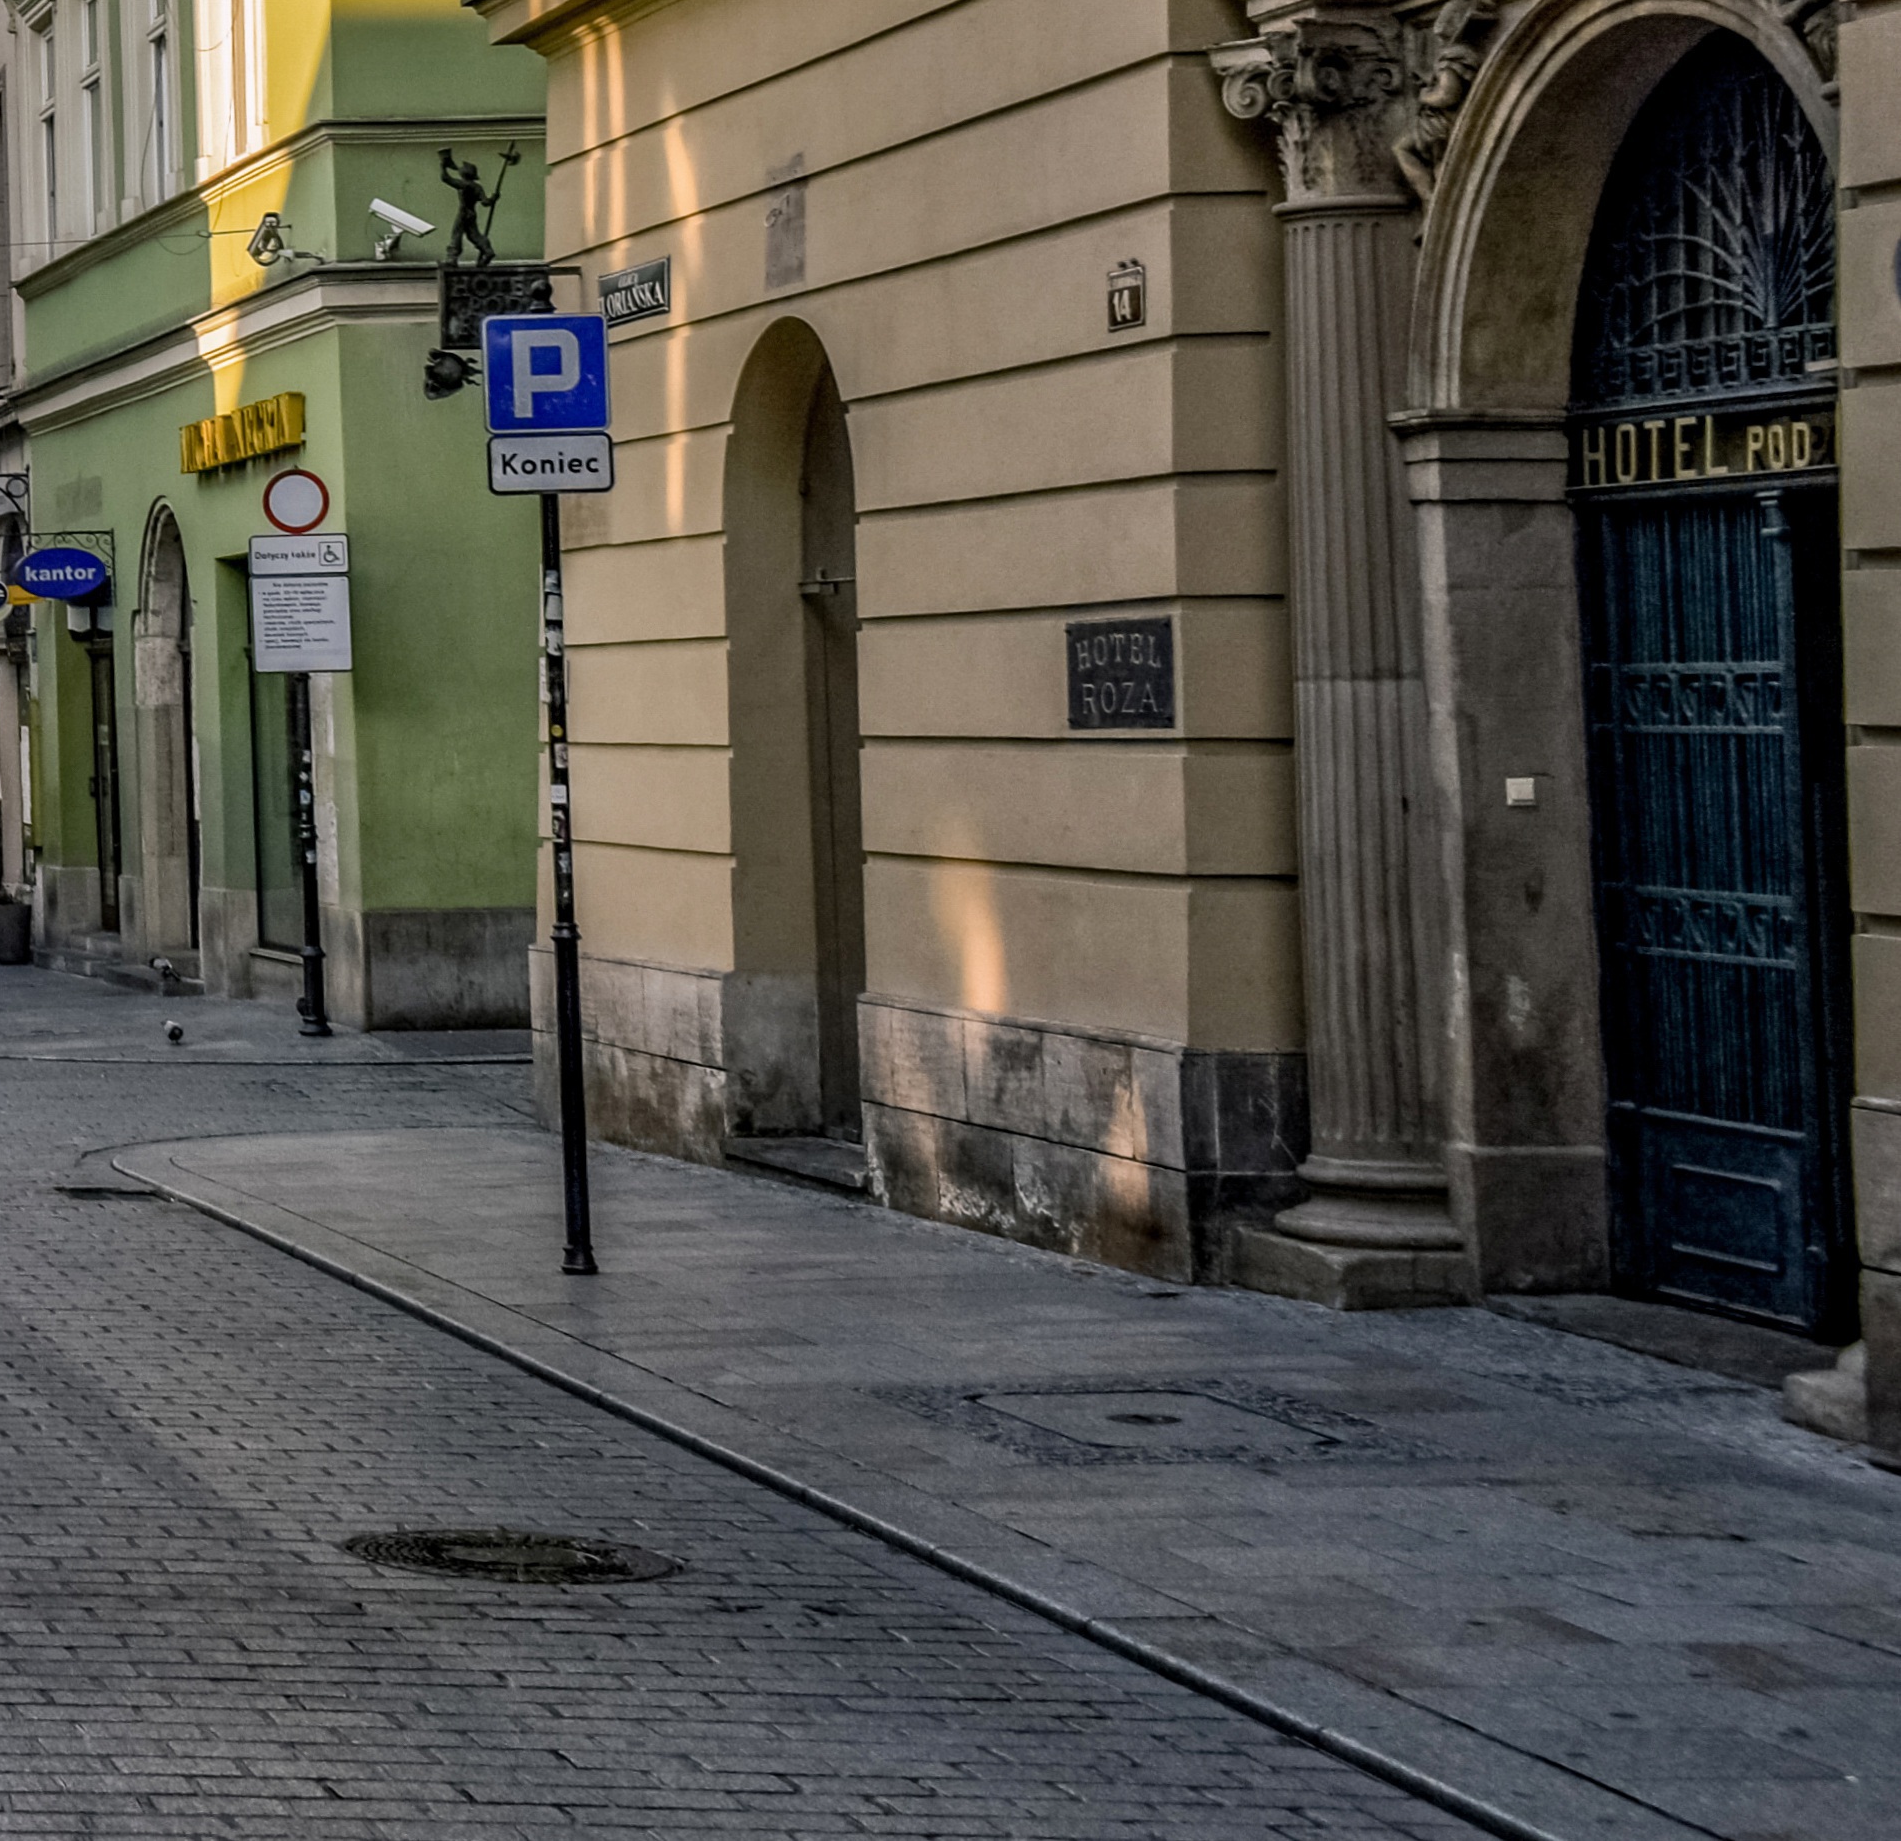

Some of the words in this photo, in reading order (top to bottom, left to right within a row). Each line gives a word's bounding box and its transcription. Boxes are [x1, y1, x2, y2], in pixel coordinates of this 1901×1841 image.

[1112, 289, 1132, 322] 14
[510, 328, 581, 419] P
[500, 451, 600, 476] Koniec
[1581, 414, 1729, 487] HOTEL
[1745, 421, 1811, 472] POD
[24, 565, 97, 582] kantor
[1075, 632, 1162, 672] HOTEL
